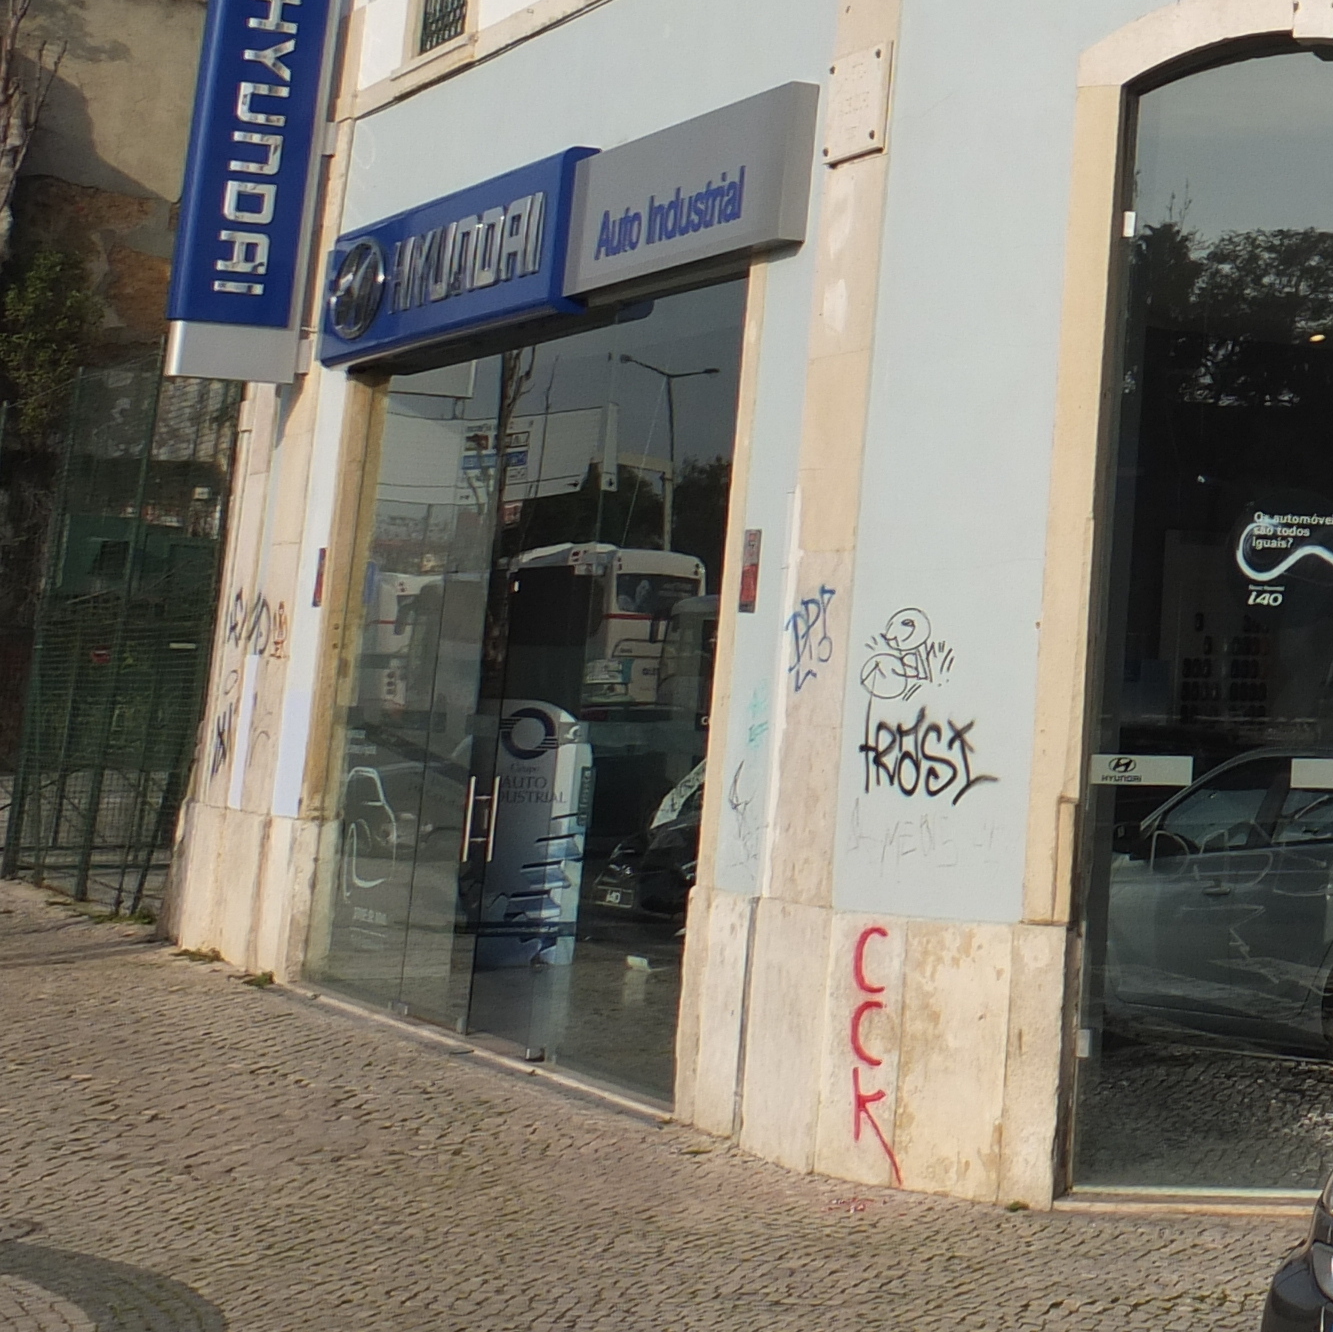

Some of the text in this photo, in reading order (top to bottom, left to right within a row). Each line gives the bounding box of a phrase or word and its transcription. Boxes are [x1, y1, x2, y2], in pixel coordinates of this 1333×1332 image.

[595, 165, 747, 260] Auto Industrial
[389, 191, 547, 315] HYUNDAI
[1276, 526, 1310, 536] todos
[502, 776, 548, 789] AUTO
